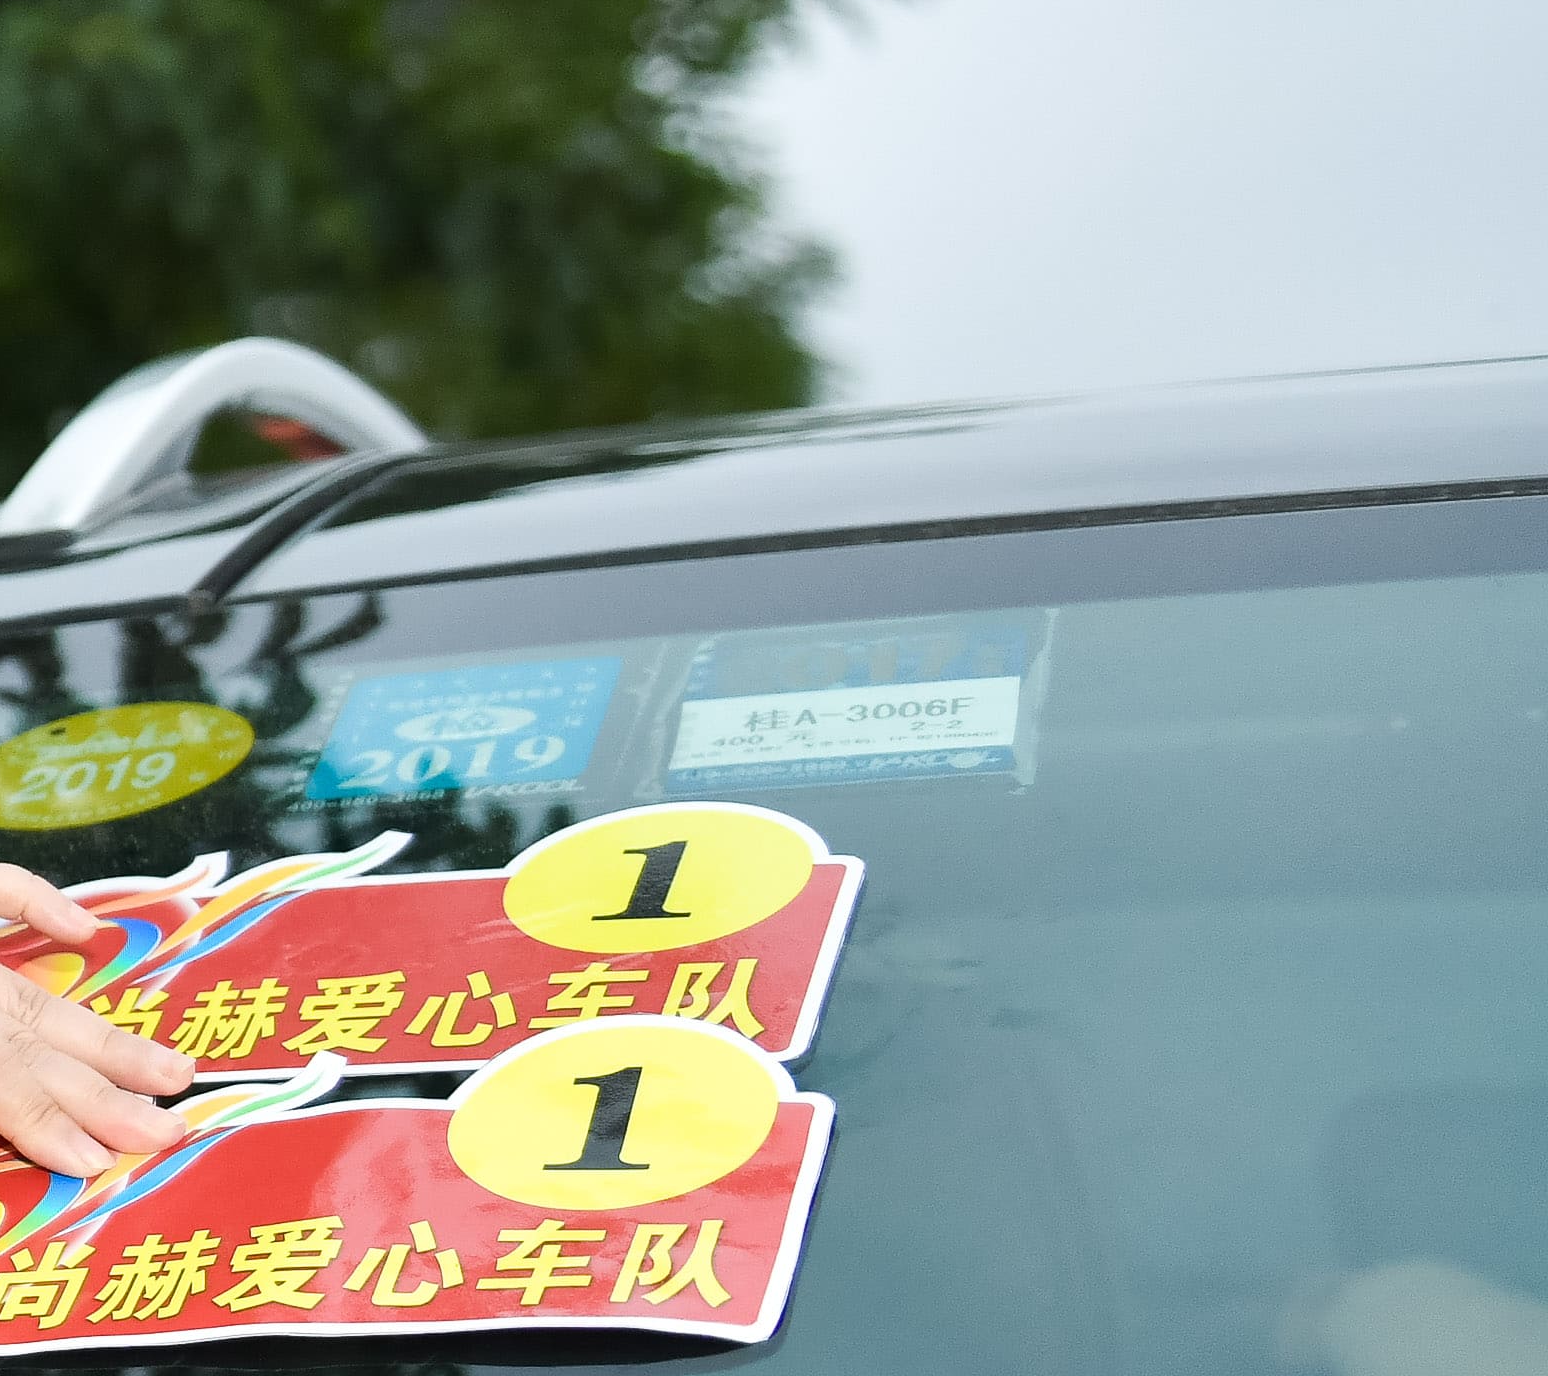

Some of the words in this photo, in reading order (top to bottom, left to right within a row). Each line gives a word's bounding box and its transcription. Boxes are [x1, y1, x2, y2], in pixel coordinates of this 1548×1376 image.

[744, 697, 974, 733] 桂A-3006F
[8, 752, 176, 804] 2019
[338, 736, 565, 788] 2019
[591, 840, 690, 921] 1
[90, 958, 765, 1059] 尚赫爱心车队
[543, 1066, 649, 1171] 1
